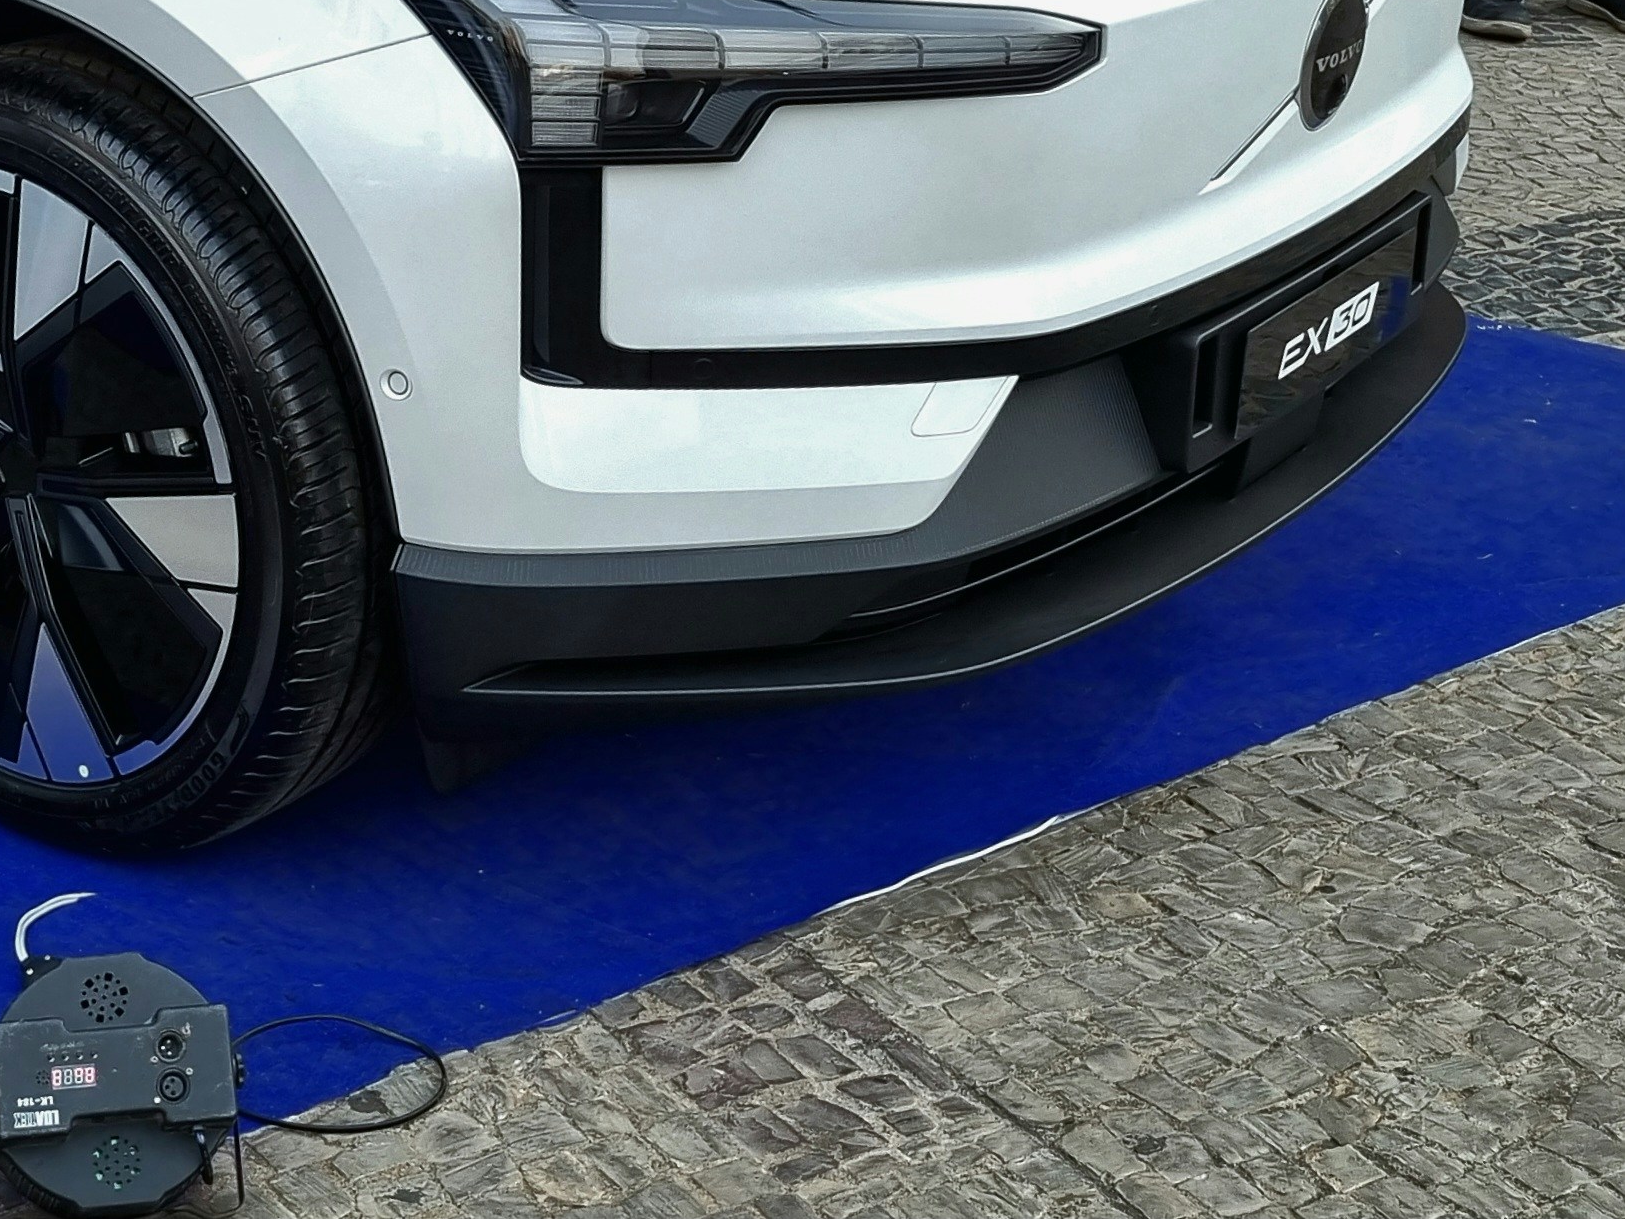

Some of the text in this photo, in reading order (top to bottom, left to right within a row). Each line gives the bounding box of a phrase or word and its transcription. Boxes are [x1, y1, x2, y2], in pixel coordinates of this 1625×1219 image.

[447, 29, 494, 43] VOLVO
[1315, 38, 1364, 73] VOLVO
[1278, 281, 1380, 380] EX30
